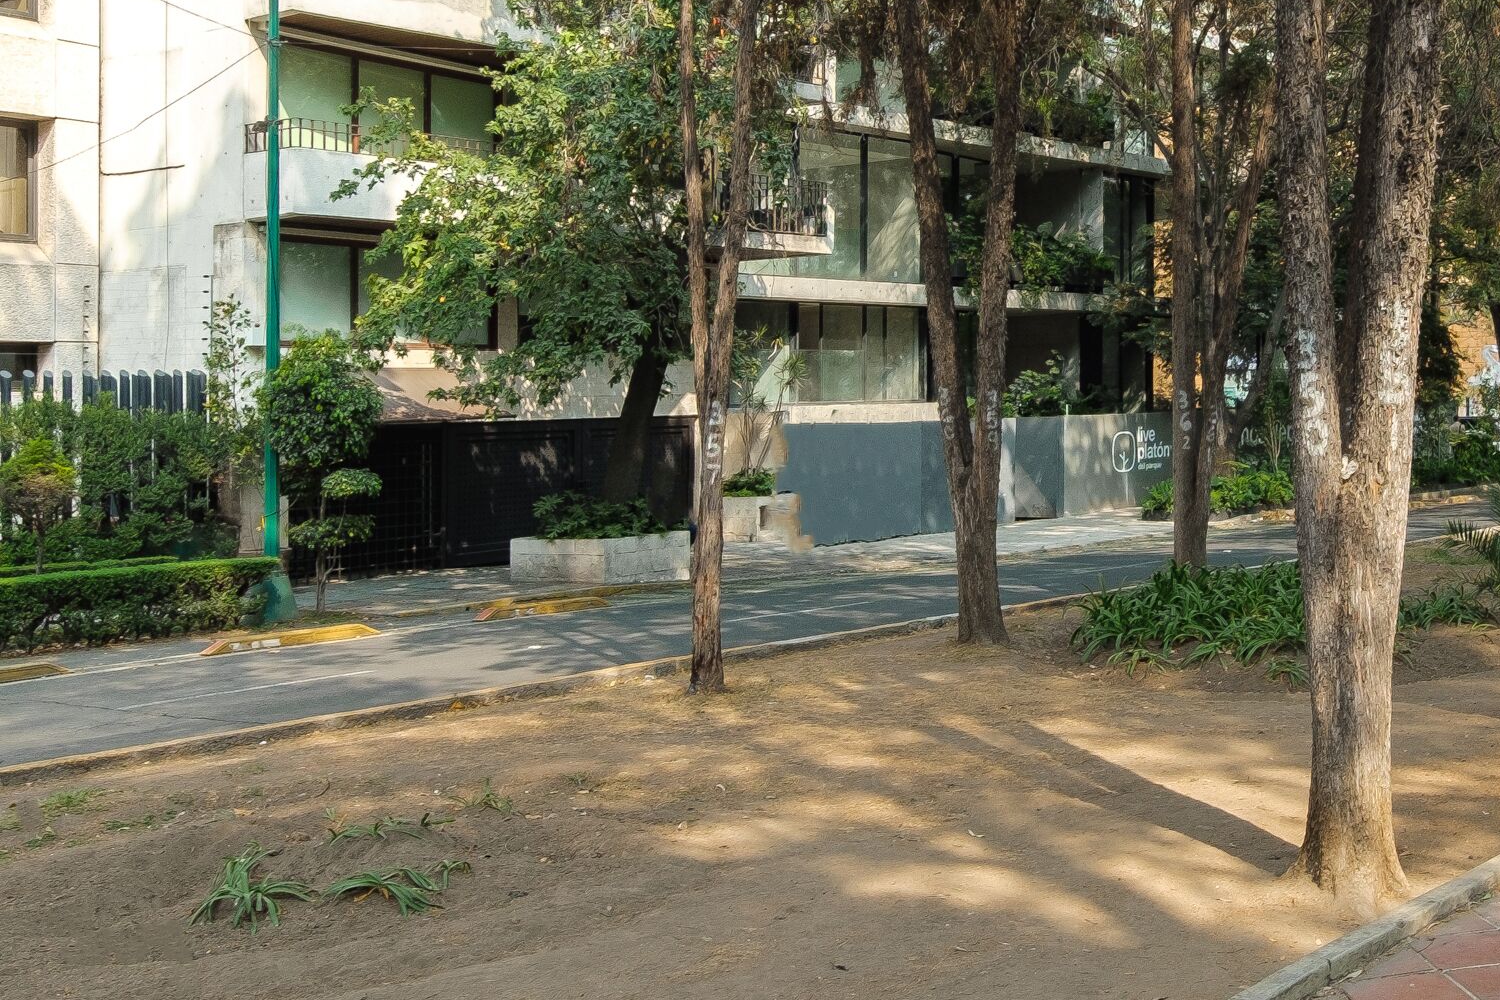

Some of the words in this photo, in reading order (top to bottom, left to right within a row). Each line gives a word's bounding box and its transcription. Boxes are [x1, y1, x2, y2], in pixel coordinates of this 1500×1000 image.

[1137, 426, 1156, 442] live
[1177, 390, 1192, 449] 362
[707, 400, 724, 485] 357
[1137, 441, 1170, 463] platón
